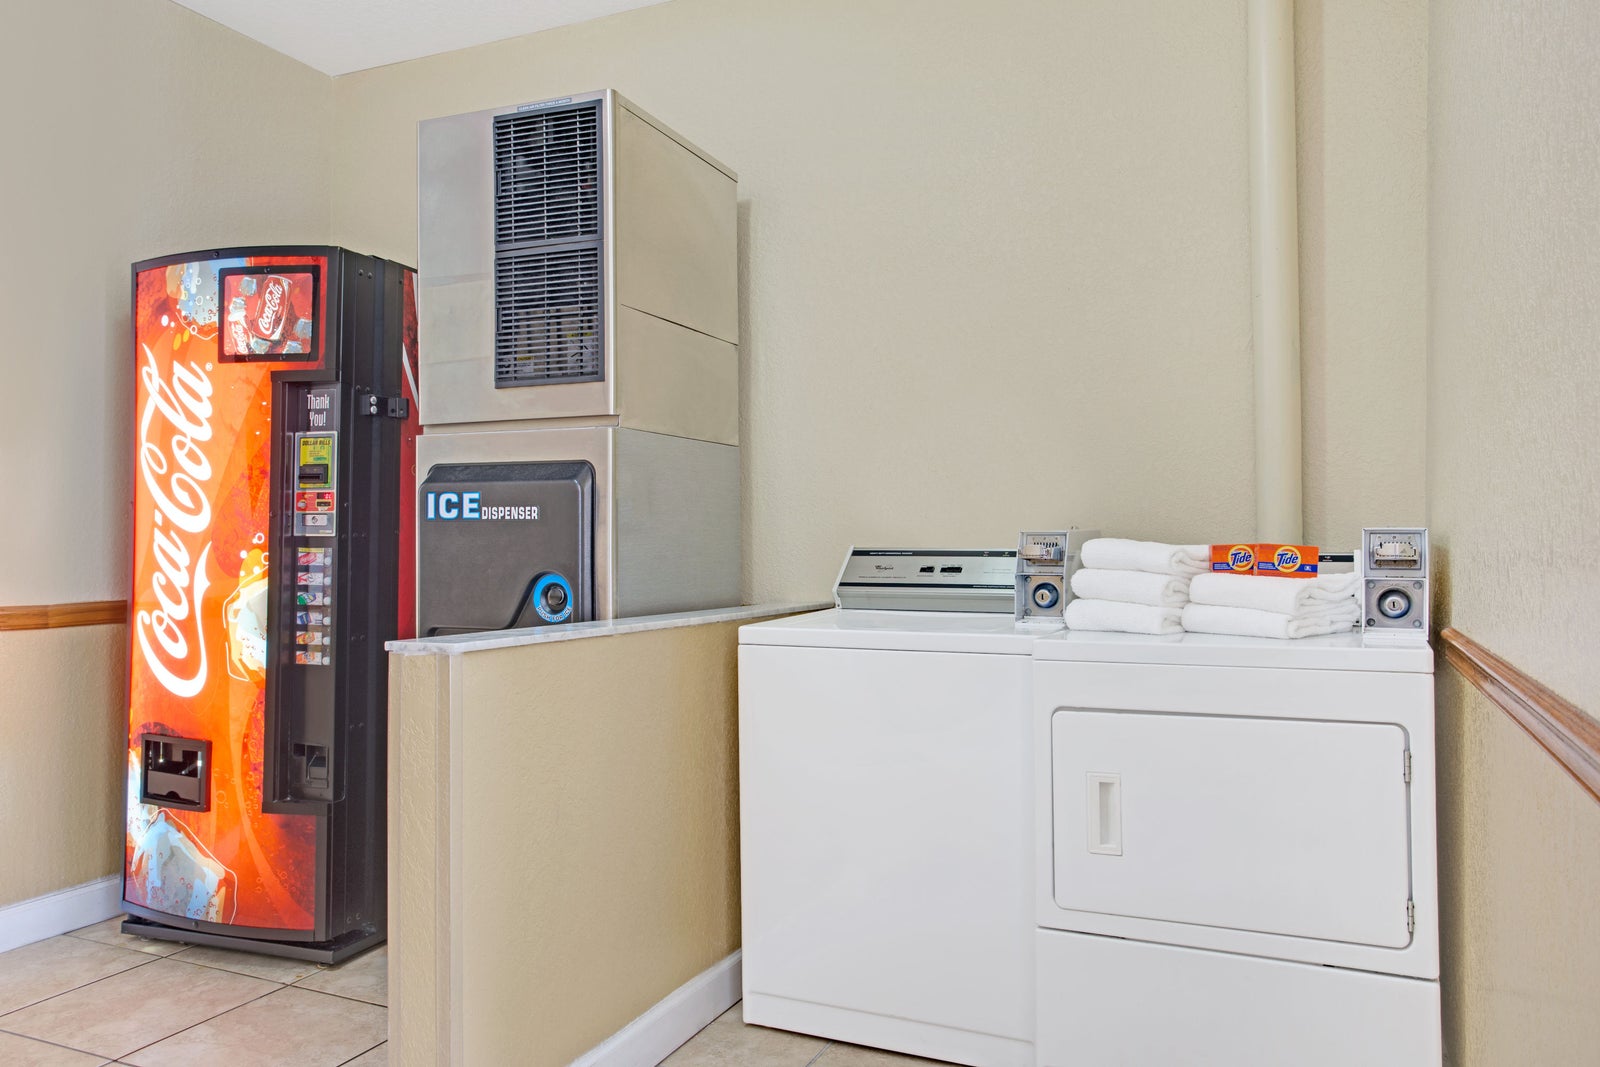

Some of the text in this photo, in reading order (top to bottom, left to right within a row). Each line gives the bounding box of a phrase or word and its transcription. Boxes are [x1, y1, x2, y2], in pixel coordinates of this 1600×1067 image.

[307, 394, 330, 410] Thank
[310, 411, 326, 427] You!
[427, 492, 538, 520] ICE DISPENSER
[136, 343, 213, 697] Coca-Cola
[1230, 551, 1252, 567] Tide
[1277, 552, 1299, 567] Tide
[537, 606, 551, 620] PUSH
